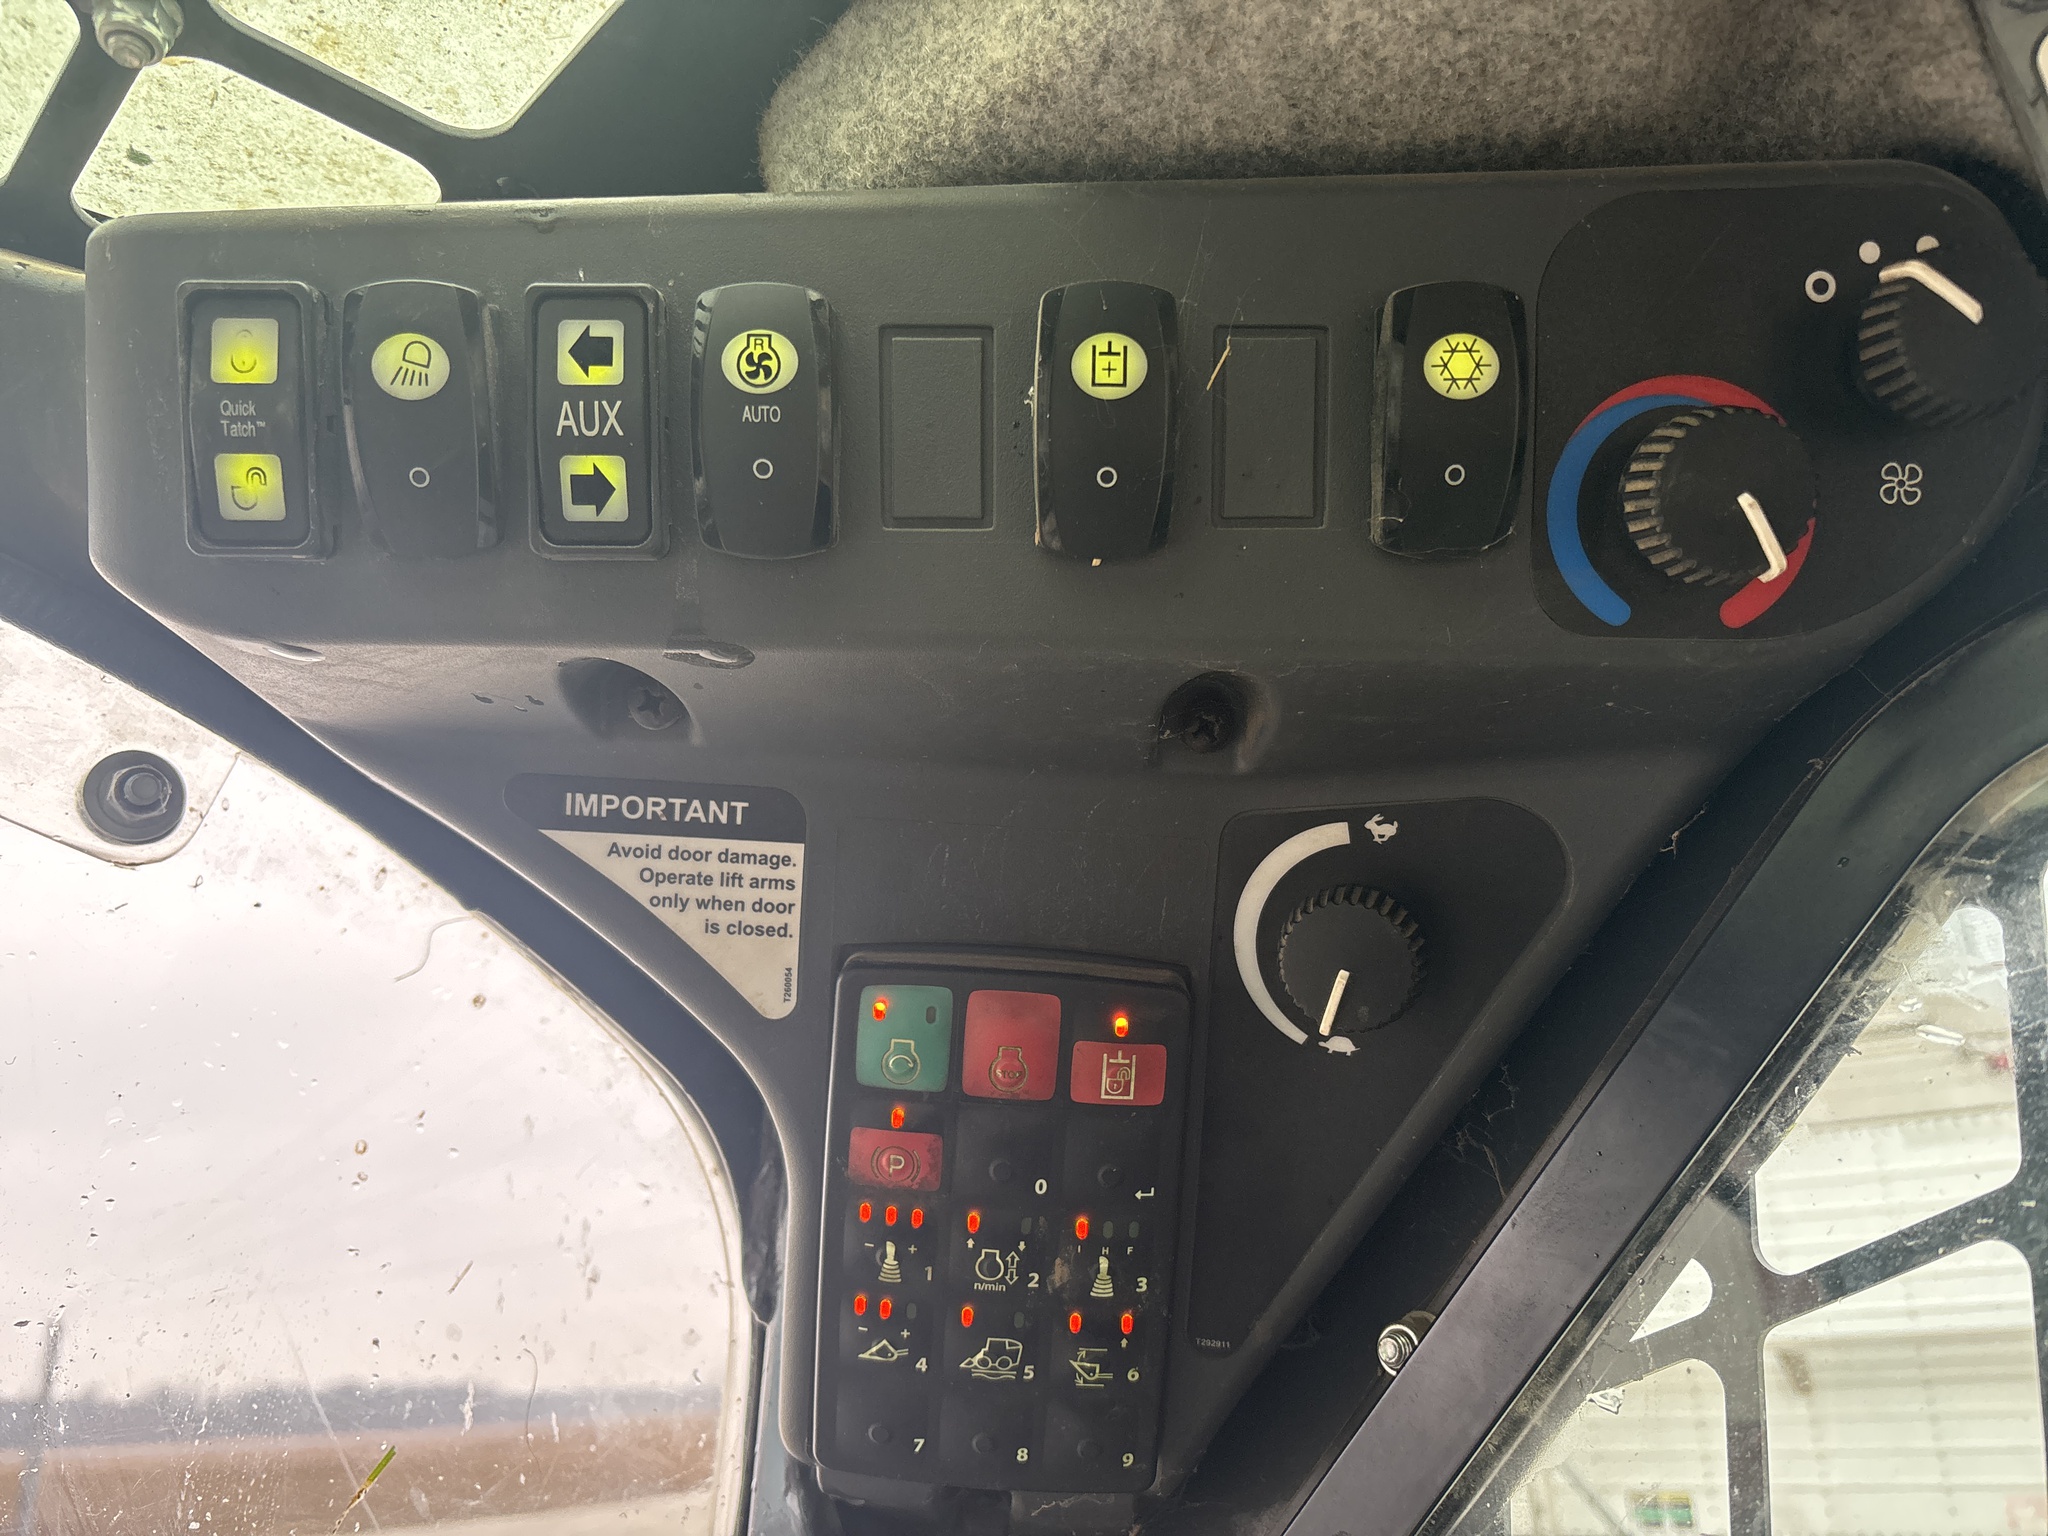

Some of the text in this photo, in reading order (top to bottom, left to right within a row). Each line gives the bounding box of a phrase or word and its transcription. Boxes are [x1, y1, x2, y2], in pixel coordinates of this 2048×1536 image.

[220, 400, 256, 416] Quick
[742, 406, 781, 423] AUTO
[556, 400, 624, 437] AUX
[565, 792, 749, 825] IMPORTANT
[607, 842, 797, 870] Avoid door damage.
[639, 867, 796, 891] Operate lift arms
[649, 893, 796, 914] only when door
[704, 918, 794, 938] is closed.
[783, 967, 793, 1003] T260054
[889, 1155, 905, 1175] P
[1034, 1178, 1048, 1195] 0
[1102, 1247, 1109, 1255] H
[1127, 1247, 1134, 1255] F
[924, 1266, 933, 1281] 1
[1028, 1273, 1040, 1288] 2
[973, 1281, 1006, 1292] n/min
[1136, 1277, 1148, 1292] 3
[915, 1358, 928, 1372] 4
[1023, 1365, 1035, 1380] 5
[1127, 1367, 1139, 1382] 6
[913, 1438, 925, 1453] 7
[1016, 1447, 1029, 1462] 8
[1122, 1453, 1134, 1467] 9
